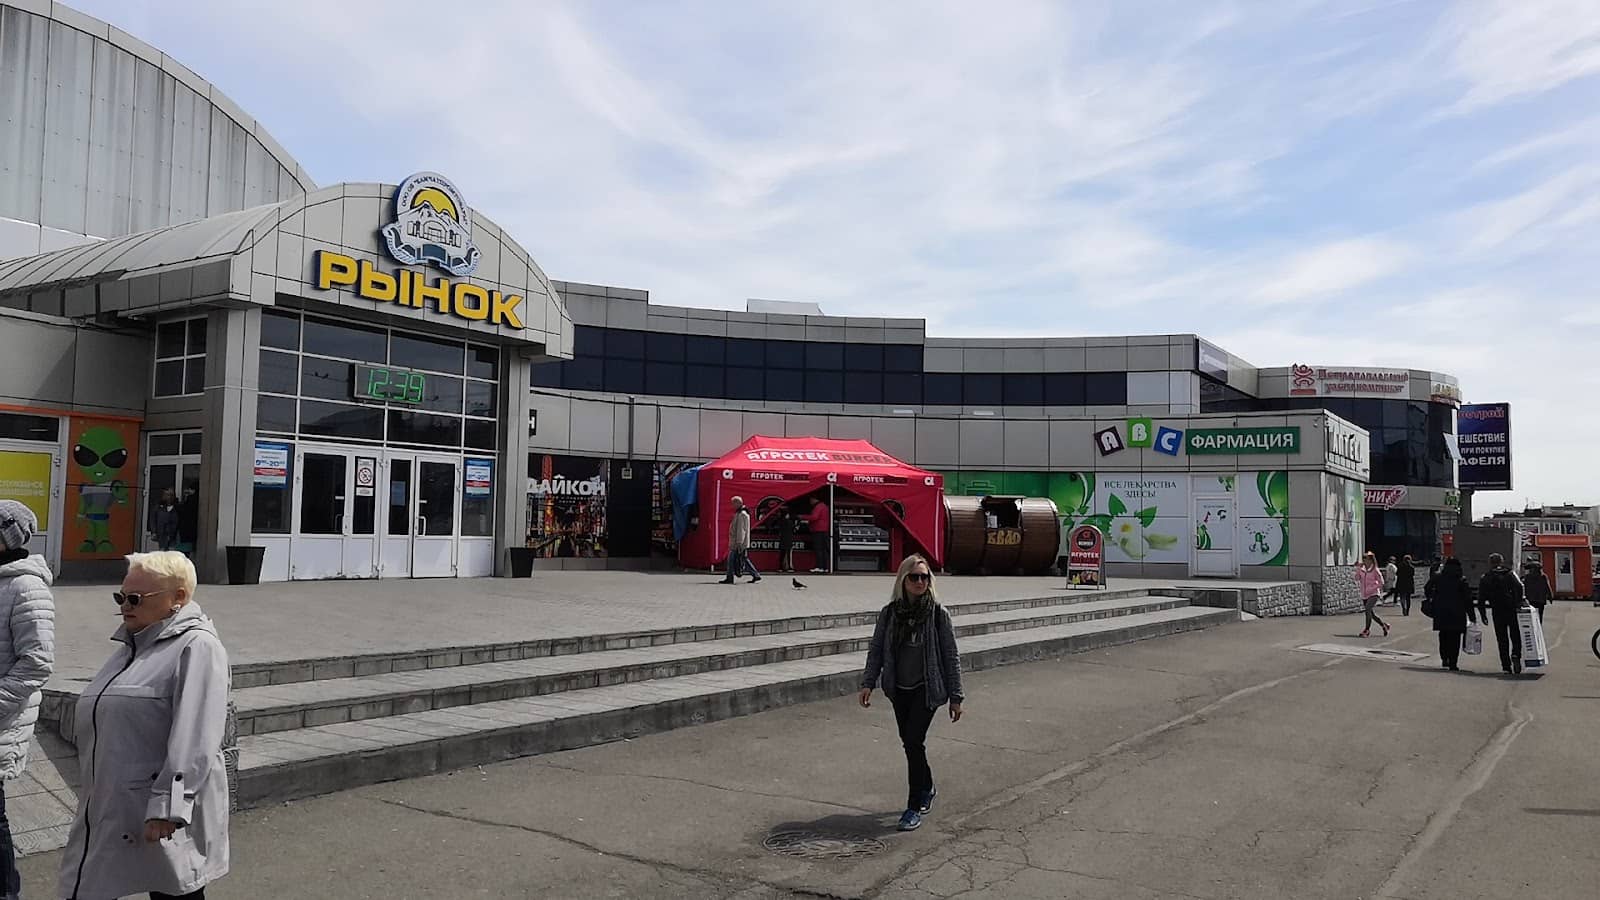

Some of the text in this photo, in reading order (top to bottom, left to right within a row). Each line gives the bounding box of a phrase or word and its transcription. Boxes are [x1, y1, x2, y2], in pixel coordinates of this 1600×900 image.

[318, 249, 524, 329] РЫНОК
[367, 368, 425, 402] 12:39
[1191, 433, 1294, 451] ФАРМАЦИЯ
[747, 450, 830, 462] АГРОТЕК
[1459, 456, 1505, 466] АФЕЛЯ
[1103, 480, 1177, 489] ВСЕ ЛЕКАРСТВА
